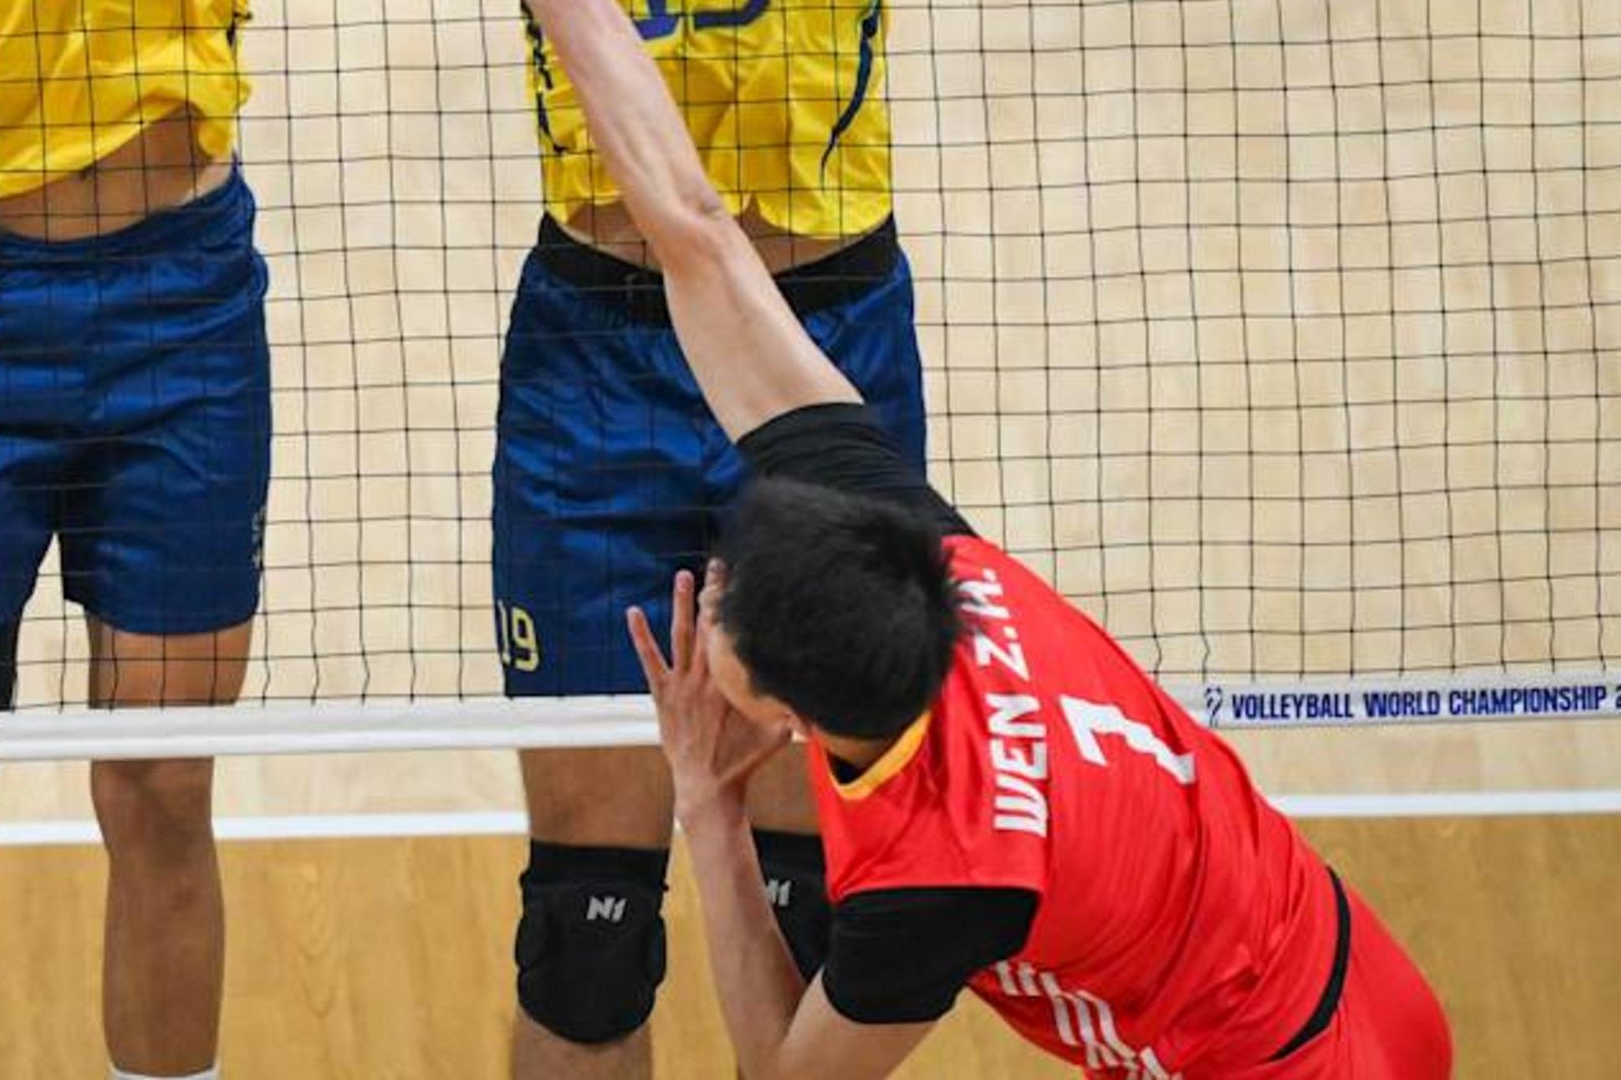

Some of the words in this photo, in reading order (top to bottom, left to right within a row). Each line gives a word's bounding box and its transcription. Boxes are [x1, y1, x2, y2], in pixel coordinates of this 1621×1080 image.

[497, 599, 540, 672] 19
[1060, 694, 1197, 786] 7
[1231, 691, 1355, 721] VOLLEYBALL
[1363, 689, 1441, 717] WORLD
[1449, 686, 1607, 715] CHAMPIONSHIP
[986, 693, 1048, 838] WEN
